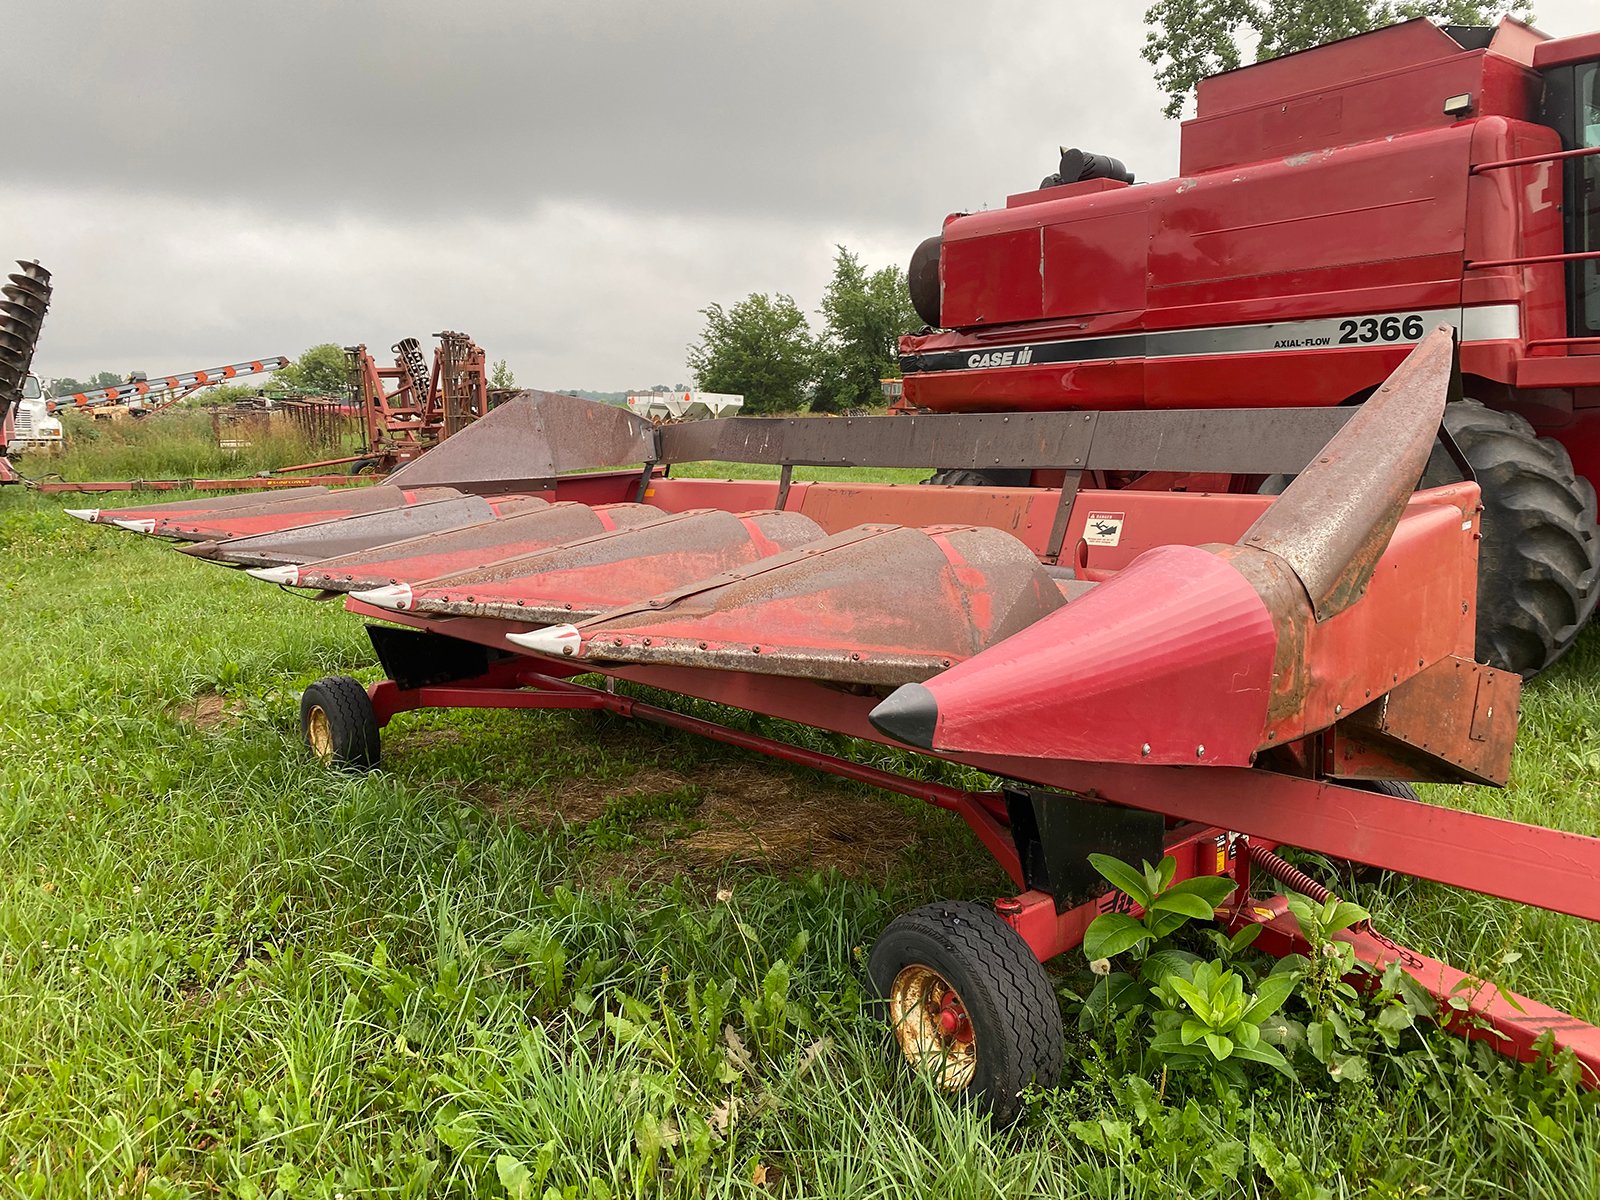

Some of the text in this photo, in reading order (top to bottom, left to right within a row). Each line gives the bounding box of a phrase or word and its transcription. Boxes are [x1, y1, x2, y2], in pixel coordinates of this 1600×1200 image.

[1338, 315, 1424, 344] 2366
[1274, 337, 1330, 348] AXIAL-FLOW
[967, 352, 1015, 368] CASE
